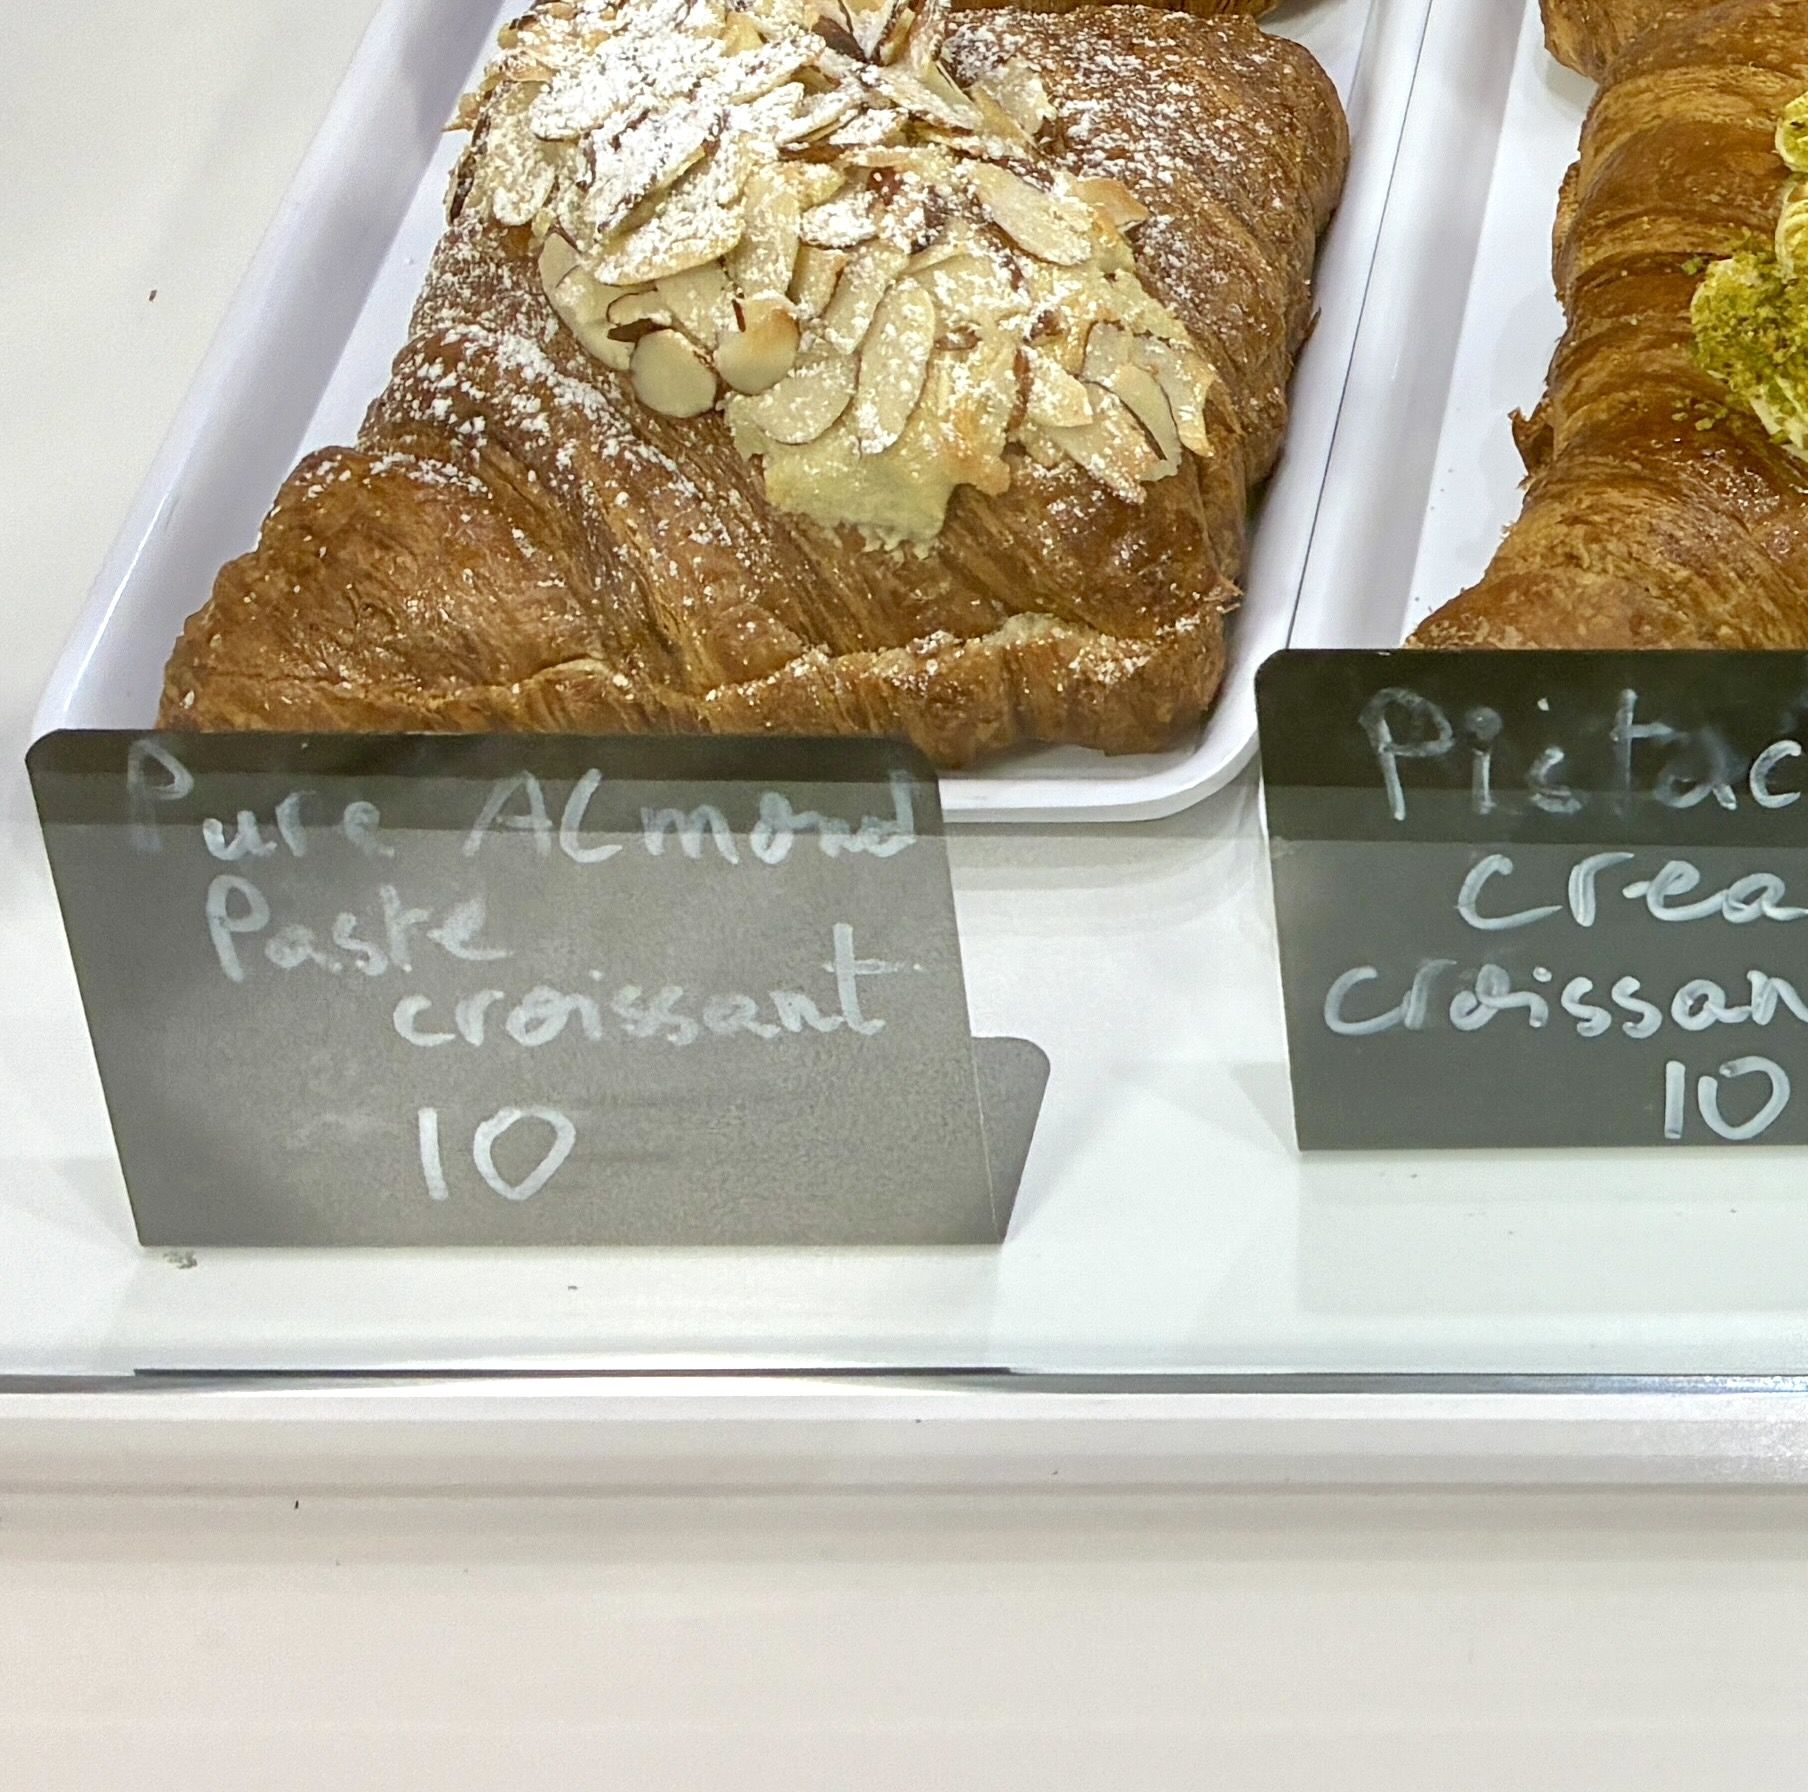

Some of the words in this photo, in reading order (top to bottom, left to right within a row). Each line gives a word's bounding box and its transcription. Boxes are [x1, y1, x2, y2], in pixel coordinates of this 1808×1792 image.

[126, 738, 396, 863] Pure
[204, 873, 512, 984] Paste
[392, 922, 924, 1048] croissant
[416, 1104, 577, 1201] 10
[1662, 1054, 1792, 1141] 10
